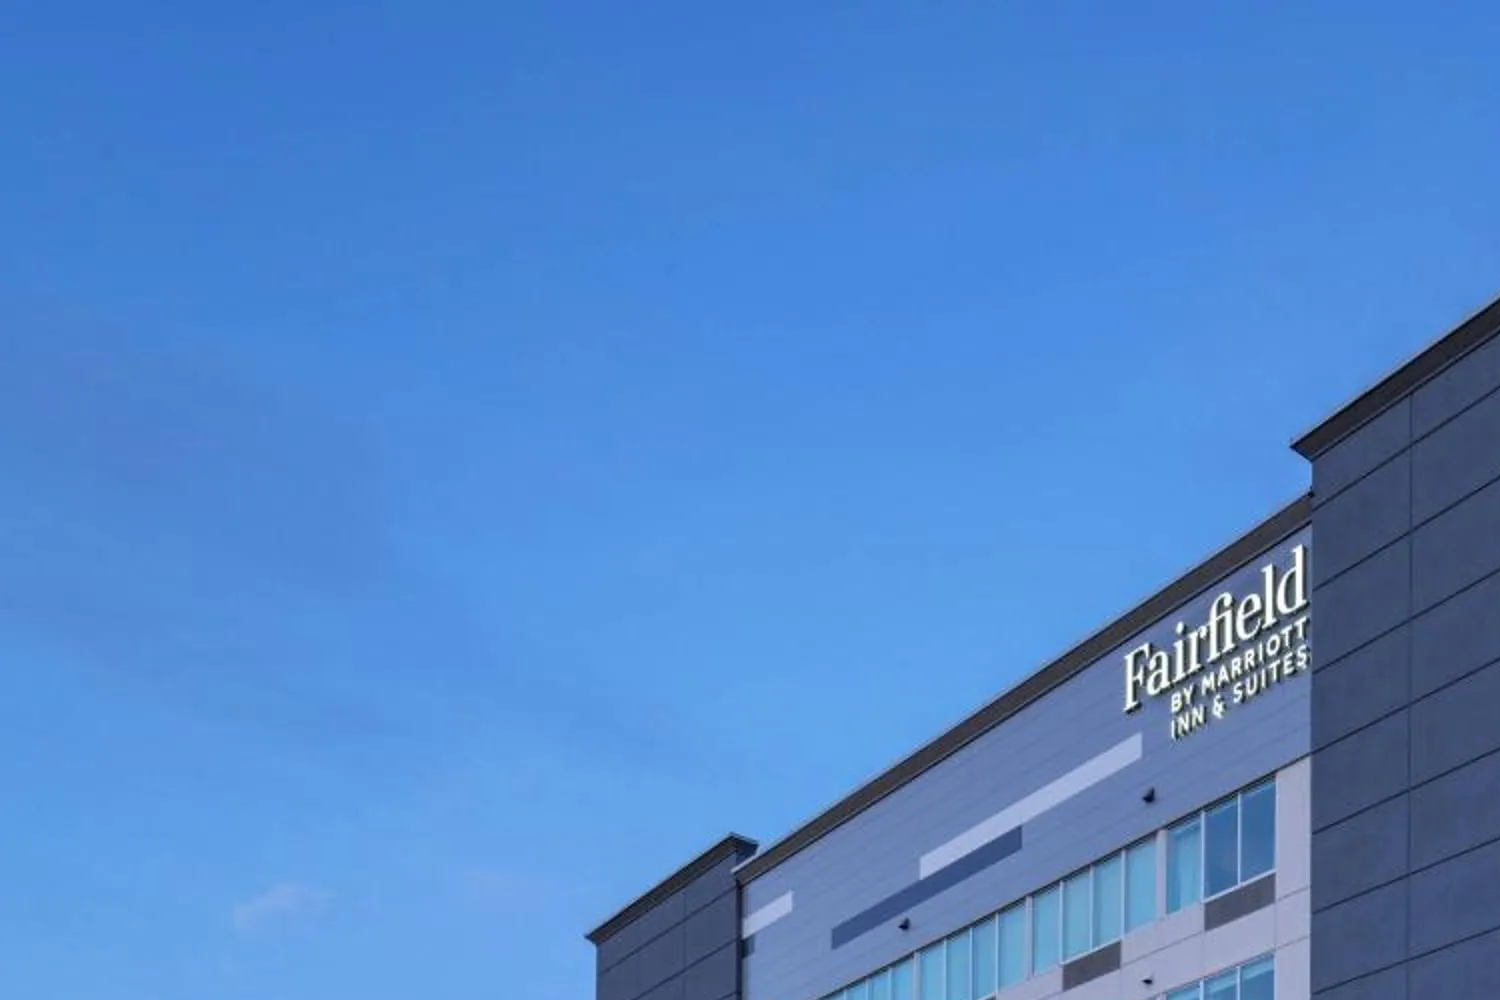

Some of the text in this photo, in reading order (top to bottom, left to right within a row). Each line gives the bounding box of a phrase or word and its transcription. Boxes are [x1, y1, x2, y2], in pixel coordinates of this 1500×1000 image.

[1123, 544, 1310, 712] Fairfield
[1171, 616, 1308, 713] BY MARRIOTT
[1171, 645, 1308, 740] INN & SUITES
